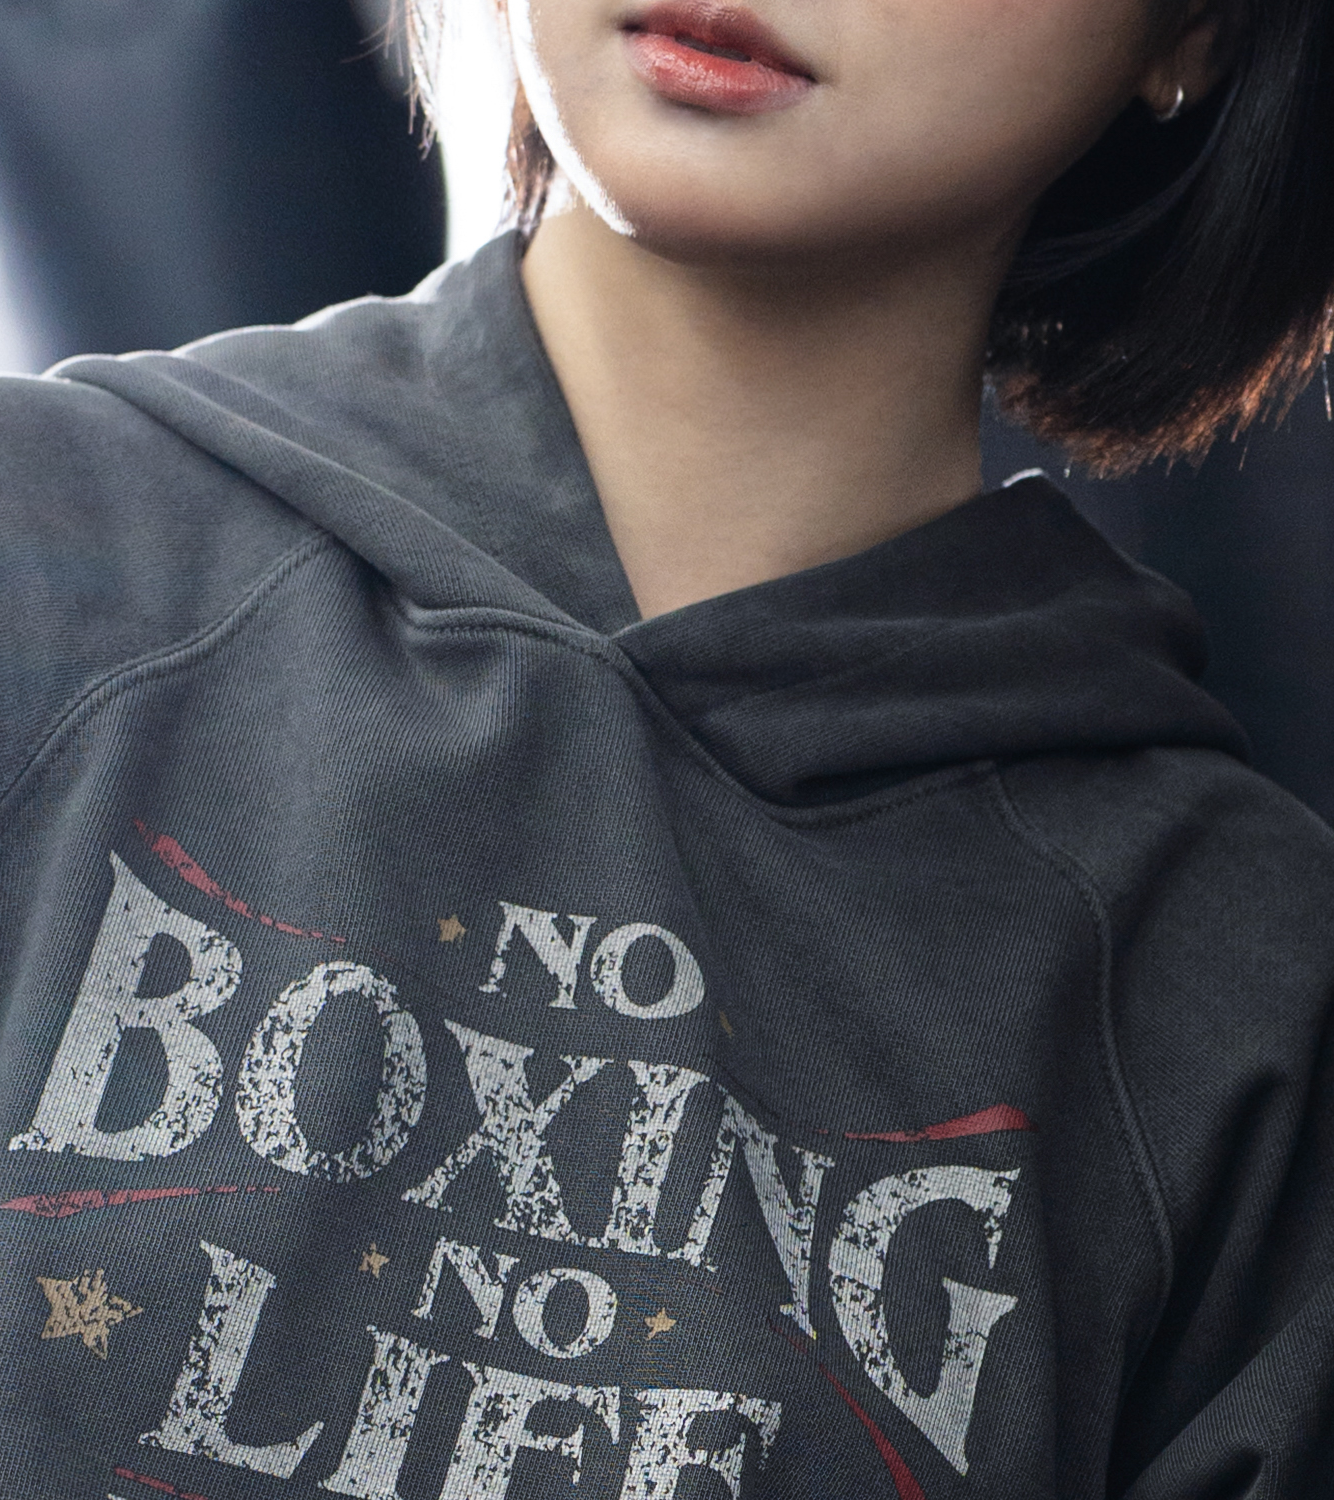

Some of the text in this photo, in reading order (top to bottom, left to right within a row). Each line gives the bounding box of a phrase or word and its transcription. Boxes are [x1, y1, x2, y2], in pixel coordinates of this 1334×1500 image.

[479, 900, 705, 1020] NO
[8, 848, 1024, 1478] BOXING
[412, 1236, 619, 1360] NO
